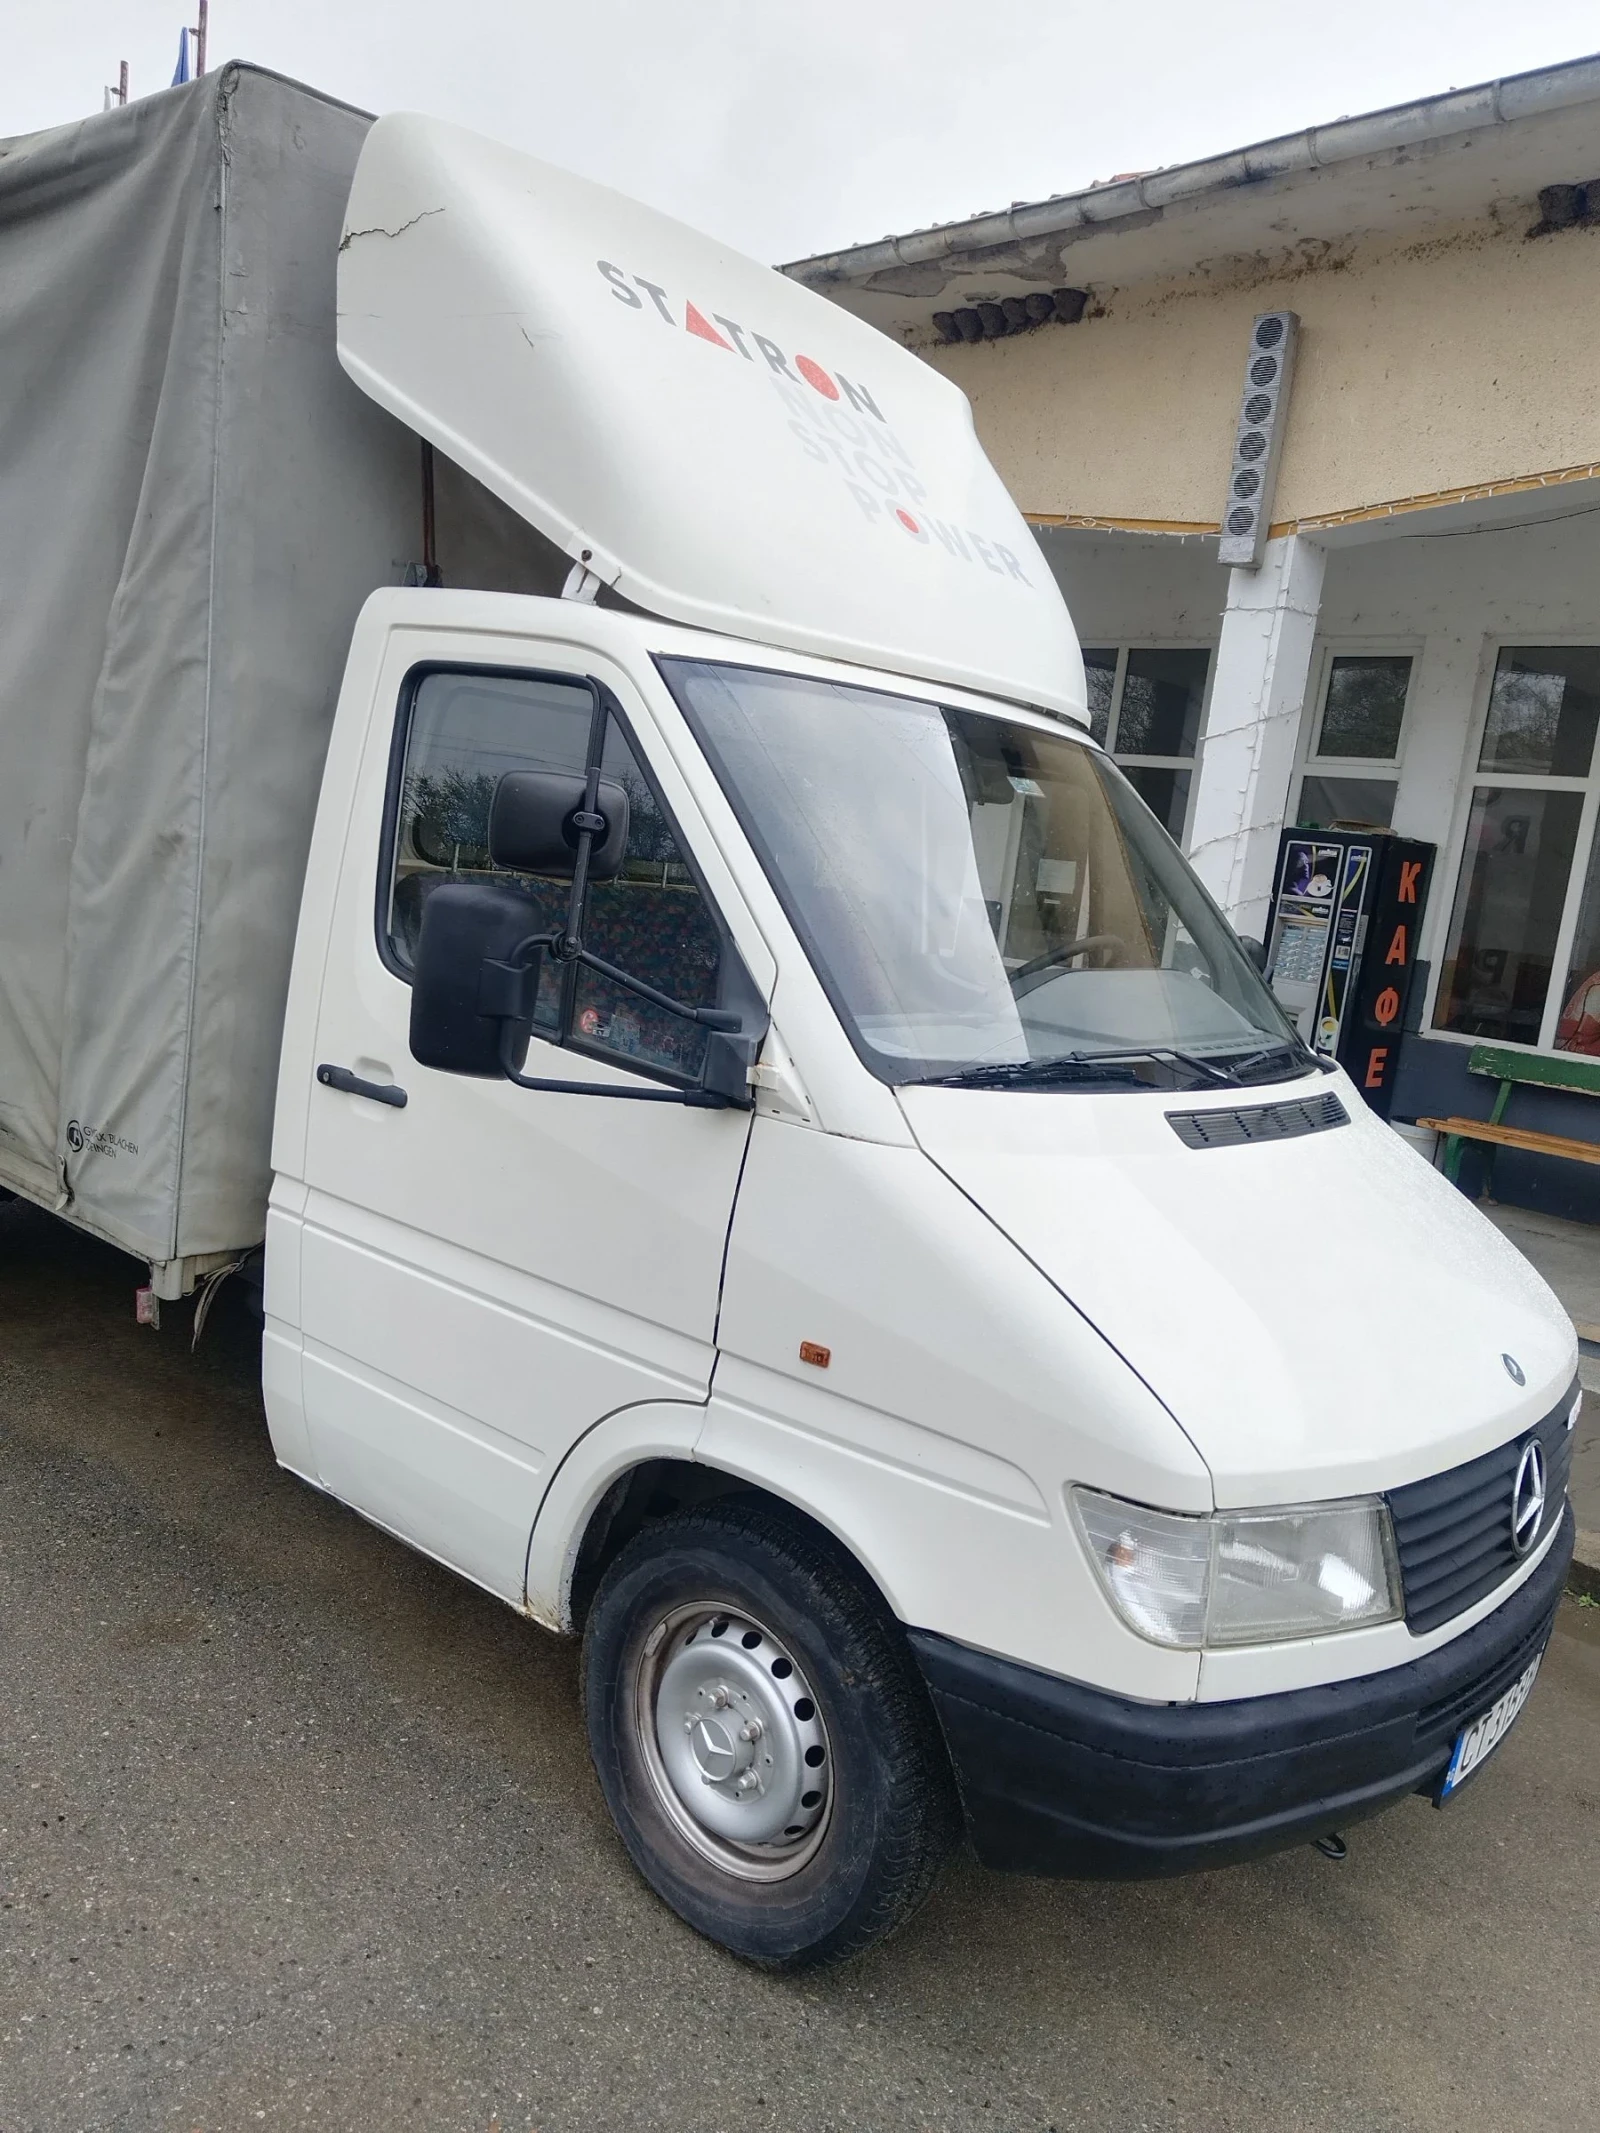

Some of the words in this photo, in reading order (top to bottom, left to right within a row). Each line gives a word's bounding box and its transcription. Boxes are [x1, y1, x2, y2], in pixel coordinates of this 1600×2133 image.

[769, 376, 917, 470] NON
[787, 418, 928, 507] STOP
[843, 477, 1036, 590] POWER
[1364, 861, 1422, 1088] КАФЕ
